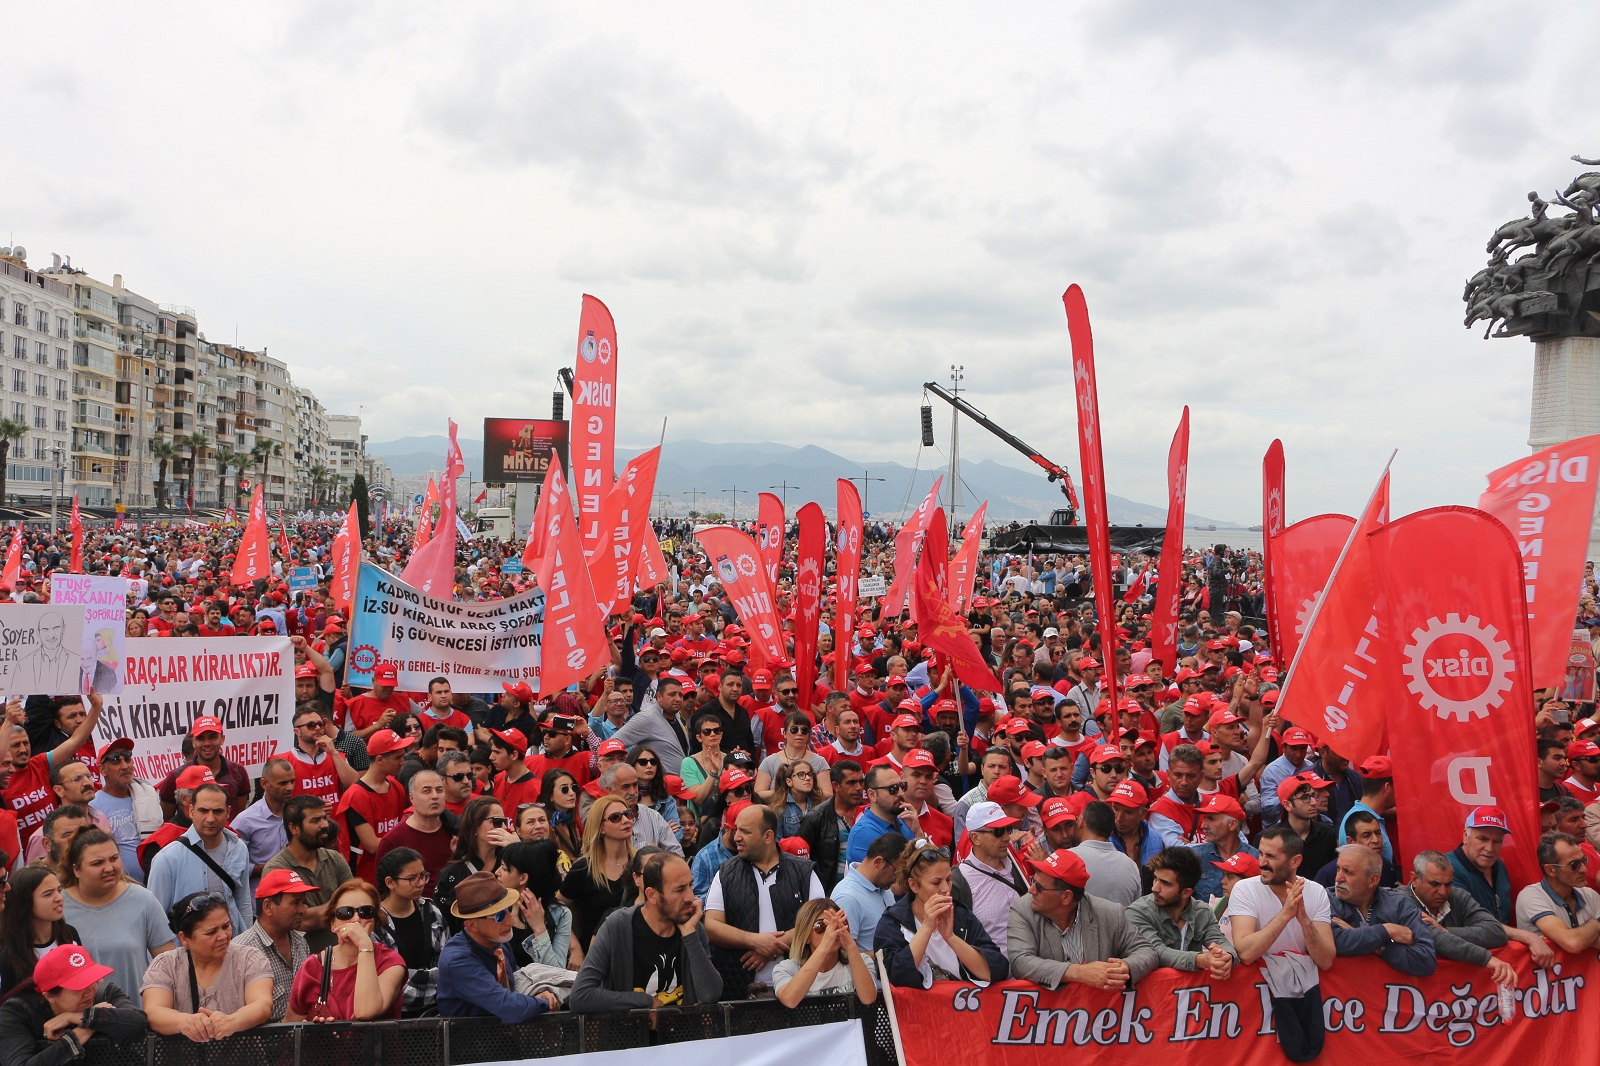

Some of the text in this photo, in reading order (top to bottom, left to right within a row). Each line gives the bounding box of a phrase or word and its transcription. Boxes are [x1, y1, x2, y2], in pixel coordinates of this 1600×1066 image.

[503, 451, 549, 471] MAYIS
[55, 590, 126, 606] BAŞKANIM
[376, 580, 420, 605] KADRO
[85, 608, 125, 624] ŞOFÖRLER
[363, 595, 399, 614] İZ-SU
[402, 607, 456, 630] KİRALIK
[460, 621, 496, 633] ARAÇ
[2, 627, 39, 646] SOYER,
[391, 621, 404, 643] İŞ
[408, 626, 487, 652] GÜVENCESİ
[192, 648, 283, 684] KİRALIKTIR.
[355, 653, 374, 663] DİSK
[408, 659, 450, 676] GENEL-İŞ
[453, 660, 482, 676] İZMİR
[492, 668, 520, 679] NO'LU
[129, 695, 206, 740] KİRALIK
[213, 693, 280, 730] OLMAZ!
[302, 774, 335, 790] DİSK
[12, 785, 48, 811] DİSK
[992, 988, 1154, 1046] Emek
[1169, 985, 1242, 1043] En
[1379, 963, 1585, 1047] Değerdir
